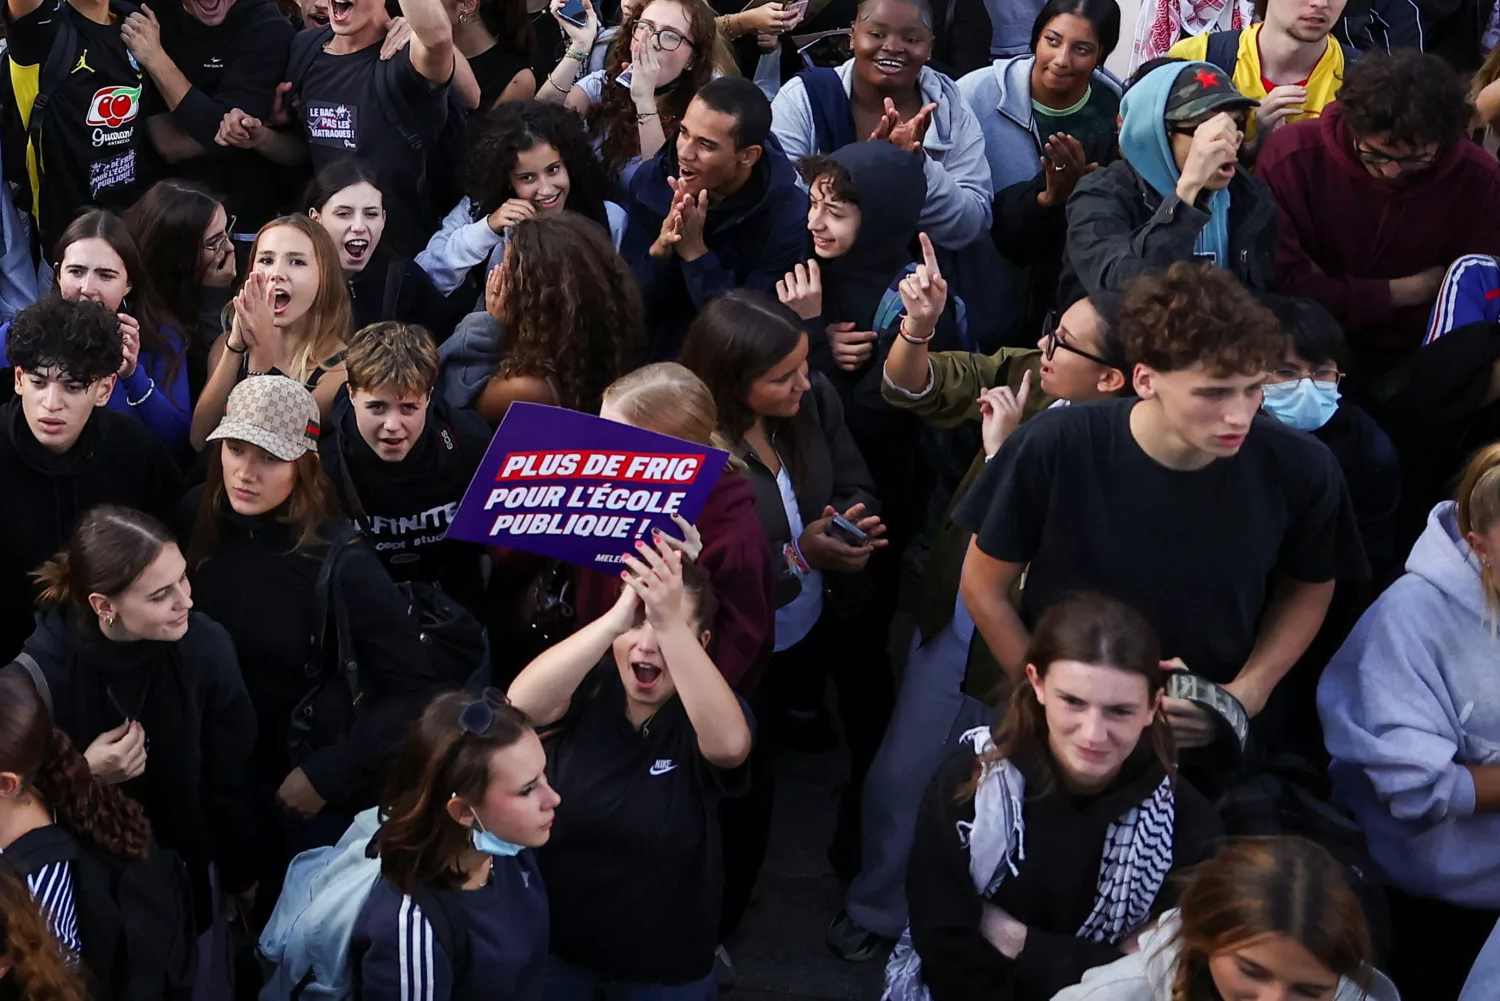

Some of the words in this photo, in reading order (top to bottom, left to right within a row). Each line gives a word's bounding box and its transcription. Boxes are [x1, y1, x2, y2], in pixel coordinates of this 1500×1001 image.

[310, 107, 319, 117] LE
[321, 117, 338, 129] PAS
[337, 119, 350, 129] LES
[311, 128, 351, 139] MATRAQUES
[91, 172, 109, 186] POUR
[500, 452, 580, 478] PLUS
[580, 454, 622, 479] DE
[624, 455, 699, 482] FRIC
[484, 486, 563, 511] POUR
[565, 482, 685, 515] L'ÉCOLE
[489, 514, 636, 540] PUBLIQUE
[635, 517, 651, 539] !
[654, 759, 672, 769] NIKE
